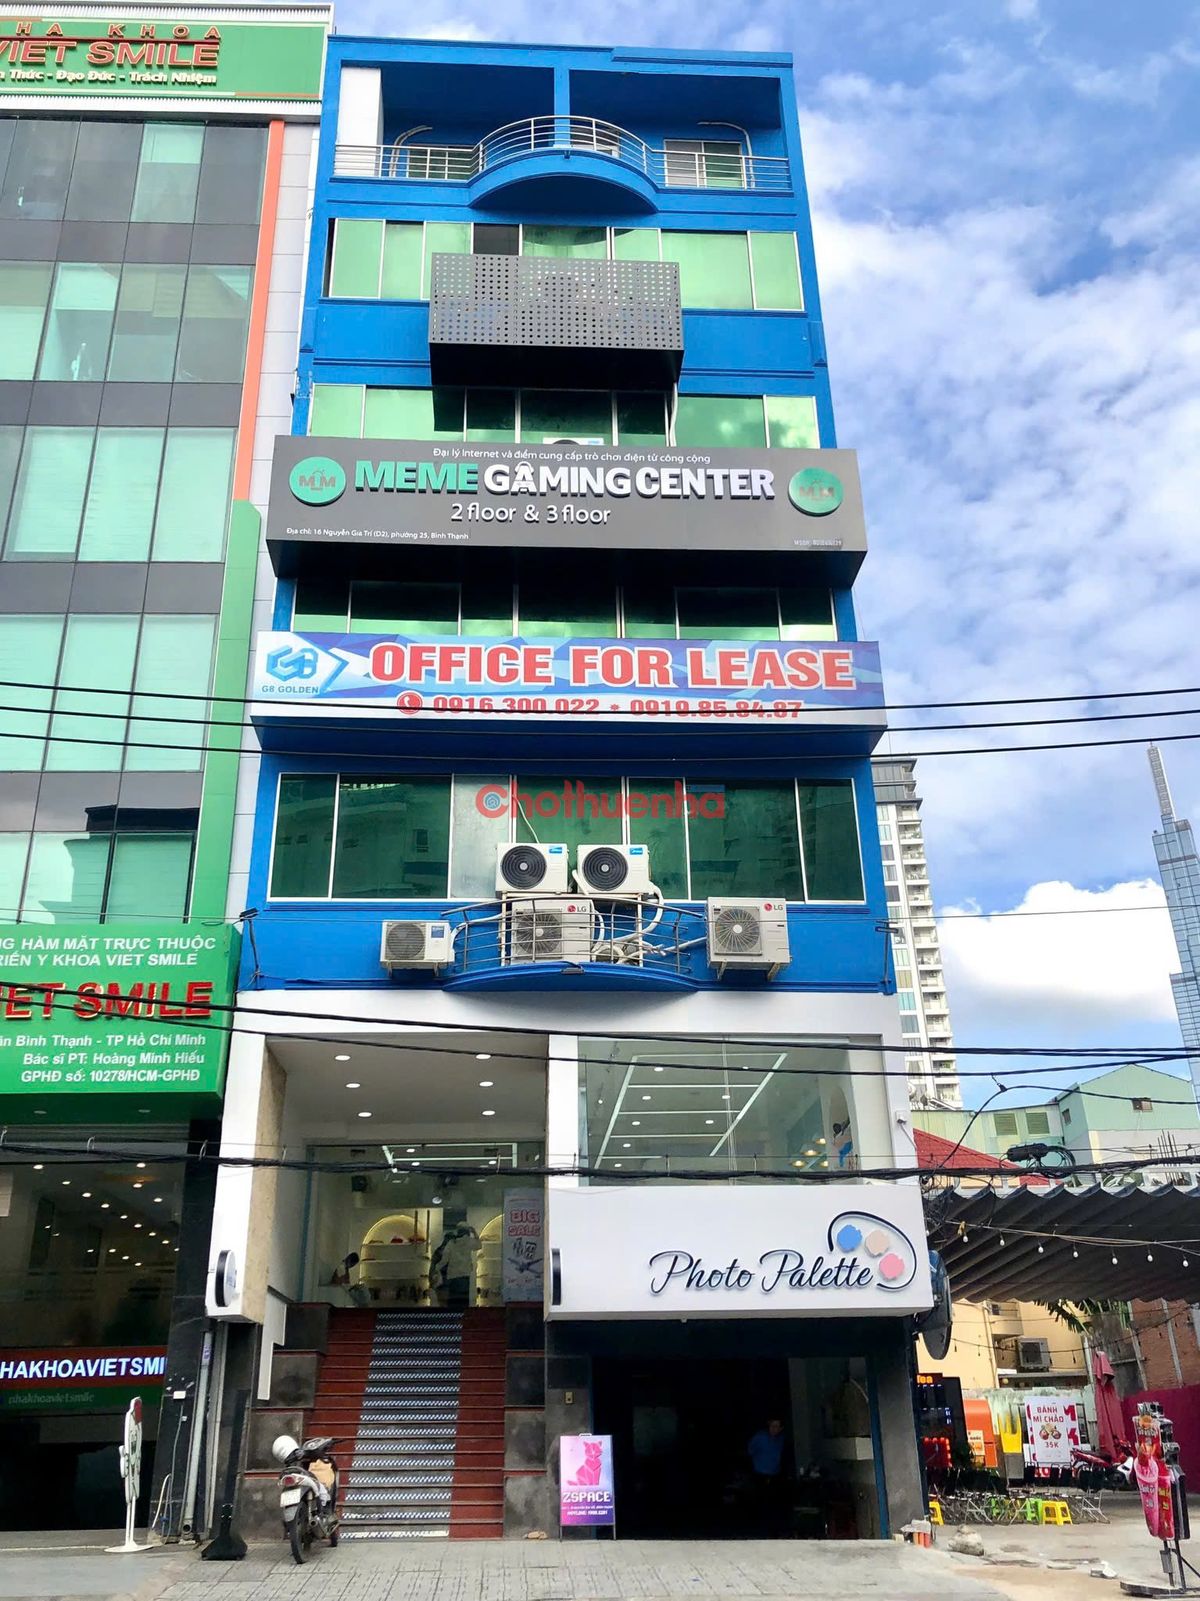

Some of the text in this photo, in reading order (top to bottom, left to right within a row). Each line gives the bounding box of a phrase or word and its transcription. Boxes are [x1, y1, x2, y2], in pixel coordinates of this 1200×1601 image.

[108, 23, 220, 39] KHOA
[86, 41, 220, 68] SMILE
[11, 69, 44, 81] Thức
[56, 70, 85, 84] Đạo
[88, 70, 116, 82] Đức
[129, 71, 168, 83] Trách
[171, 72, 217, 85] Nhiệm
[433, 448, 711, 465] Đại lý Internet và điểm cung cấp trò chơi điện tử công cộng
[355, 460, 775, 499] MEME GAMING CENTER
[451, 502, 611, 524] 2 floor & 3 floor
[286, 527, 298, 536] Địa
[323, 528, 350, 538] Nguyễn
[364, 529, 373, 537] Trí
[374, 530, 389, 538] (D2),
[391, 531, 418, 540] phường
[419, 532, 430, 540] 25,
[447, 532, 469, 541] Thạnh
[370, 643, 855, 689] OFFICE FOR LEASE
[278, 686, 319, 694] GOLDEN
[433, 696, 600, 714] 0916300022
[0, 934, 217, 952] G HÀM MẶT TRỰC THUỘC
[37, 954, 49, 966] Y
[52, 954, 101, 966] KHOA
[106, 953, 144, 966] VIET
[147, 953, 198, 965] SMILE
[0, 981, 214, 1019] ET SMILE
[16, 1035, 47, 1046] Bình
[52, 1035, 92, 1049] Thạnh
[106, 1035, 124, 1046] TP
[127, 1032, 146, 1046] Hồ
[149, 1033, 172, 1046] Chí
[174, 1033, 206, 1045] Minh
[23, 1053, 49, 1065] Bác
[67, 1053, 88, 1064] PT:
[93, 1052, 136, 1067] Hoàng
[139, 1052, 171, 1064] Minh
[174, 1050, 205, 1064] Hiếu
[21, 1068, 200, 1082] GPHĐ số: 10278/HCM-GPHĐ
[510, 1209, 539, 1223] BIG
[508, 1225, 541, 1237] SALE
[648, 1249, 874, 1295] Photo Palette
[0, 1356, 167, 1380] HAKHOAVIETSMI
[562, 1491, 611, 1503] ZSPACE
